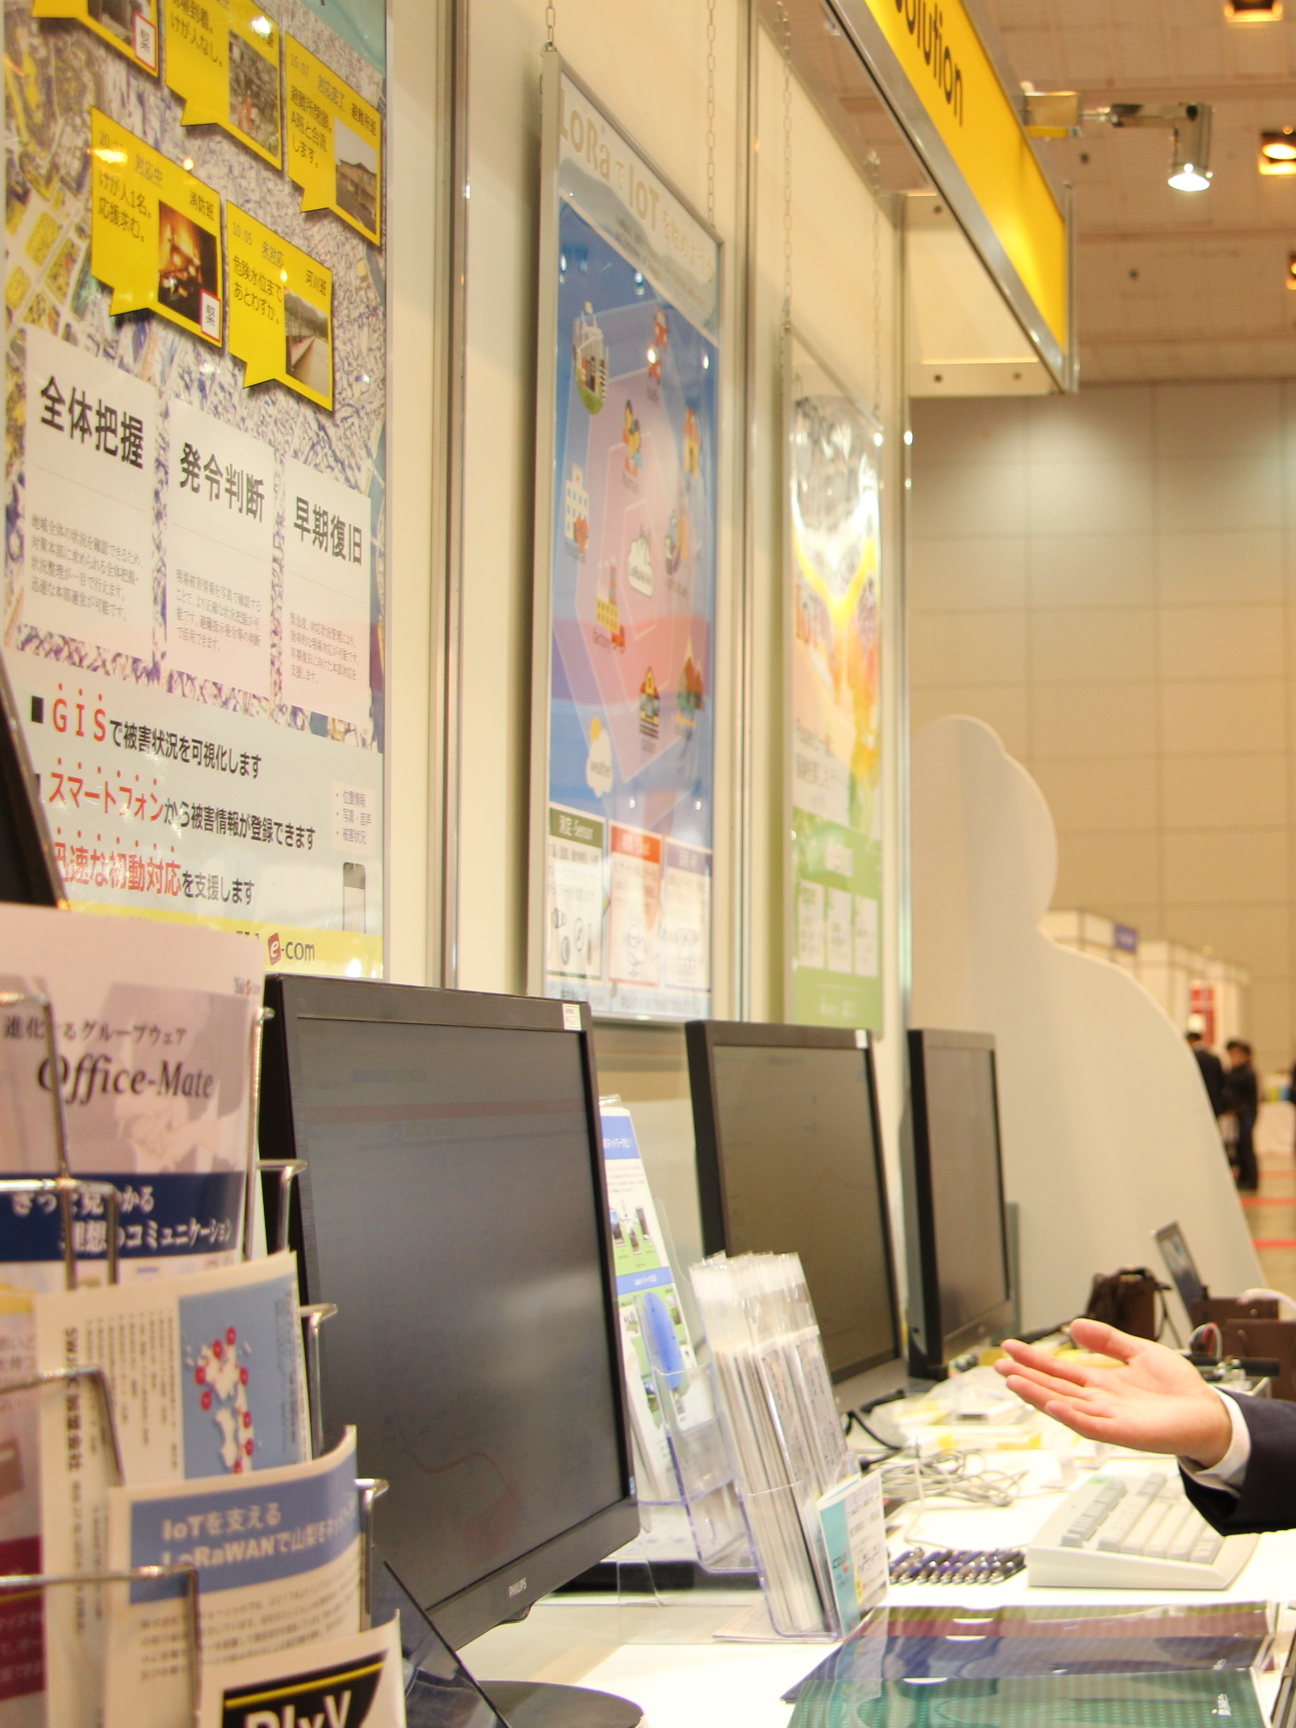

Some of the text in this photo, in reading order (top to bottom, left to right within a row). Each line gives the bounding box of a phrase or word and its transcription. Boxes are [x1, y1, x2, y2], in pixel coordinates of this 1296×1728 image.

[894, 0, 963, 127] olution
[40, 376, 144, 470] 全体把握
[180, 442, 265, 522] 発令判断
[293, 496, 363, 566] 早期復旧
[48, 771, 316, 851] スマートフォンから被害情報が登録できます
[4, 1014, 187, 1046] 進化るグループウェア
[37, 1052, 215, 1106] Office-Mate
[161, 1502, 282, 1543] IoTを支える
